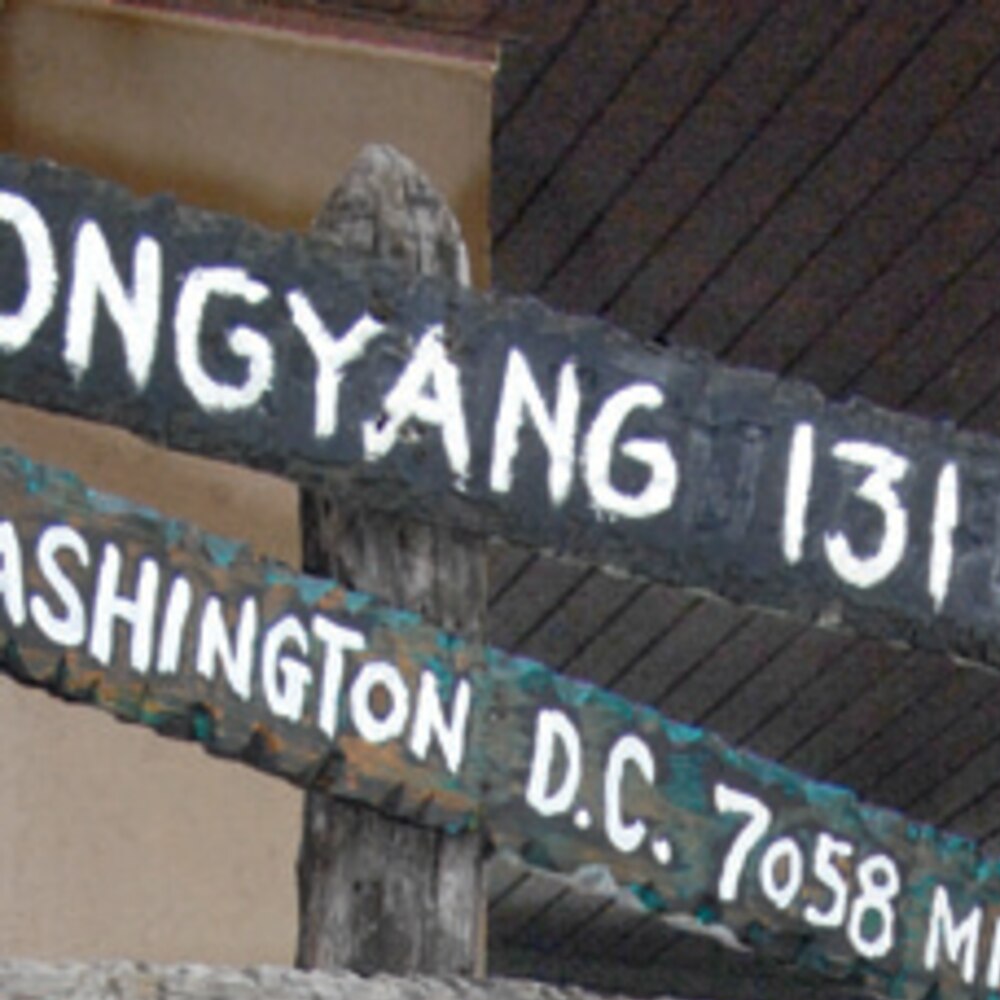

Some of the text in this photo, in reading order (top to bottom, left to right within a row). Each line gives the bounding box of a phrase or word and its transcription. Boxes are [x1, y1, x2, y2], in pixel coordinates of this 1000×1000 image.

[781, 423, 960, 612] 131
[526, 708, 672, 864] D.C.
[714, 784, 900, 958] 7058
